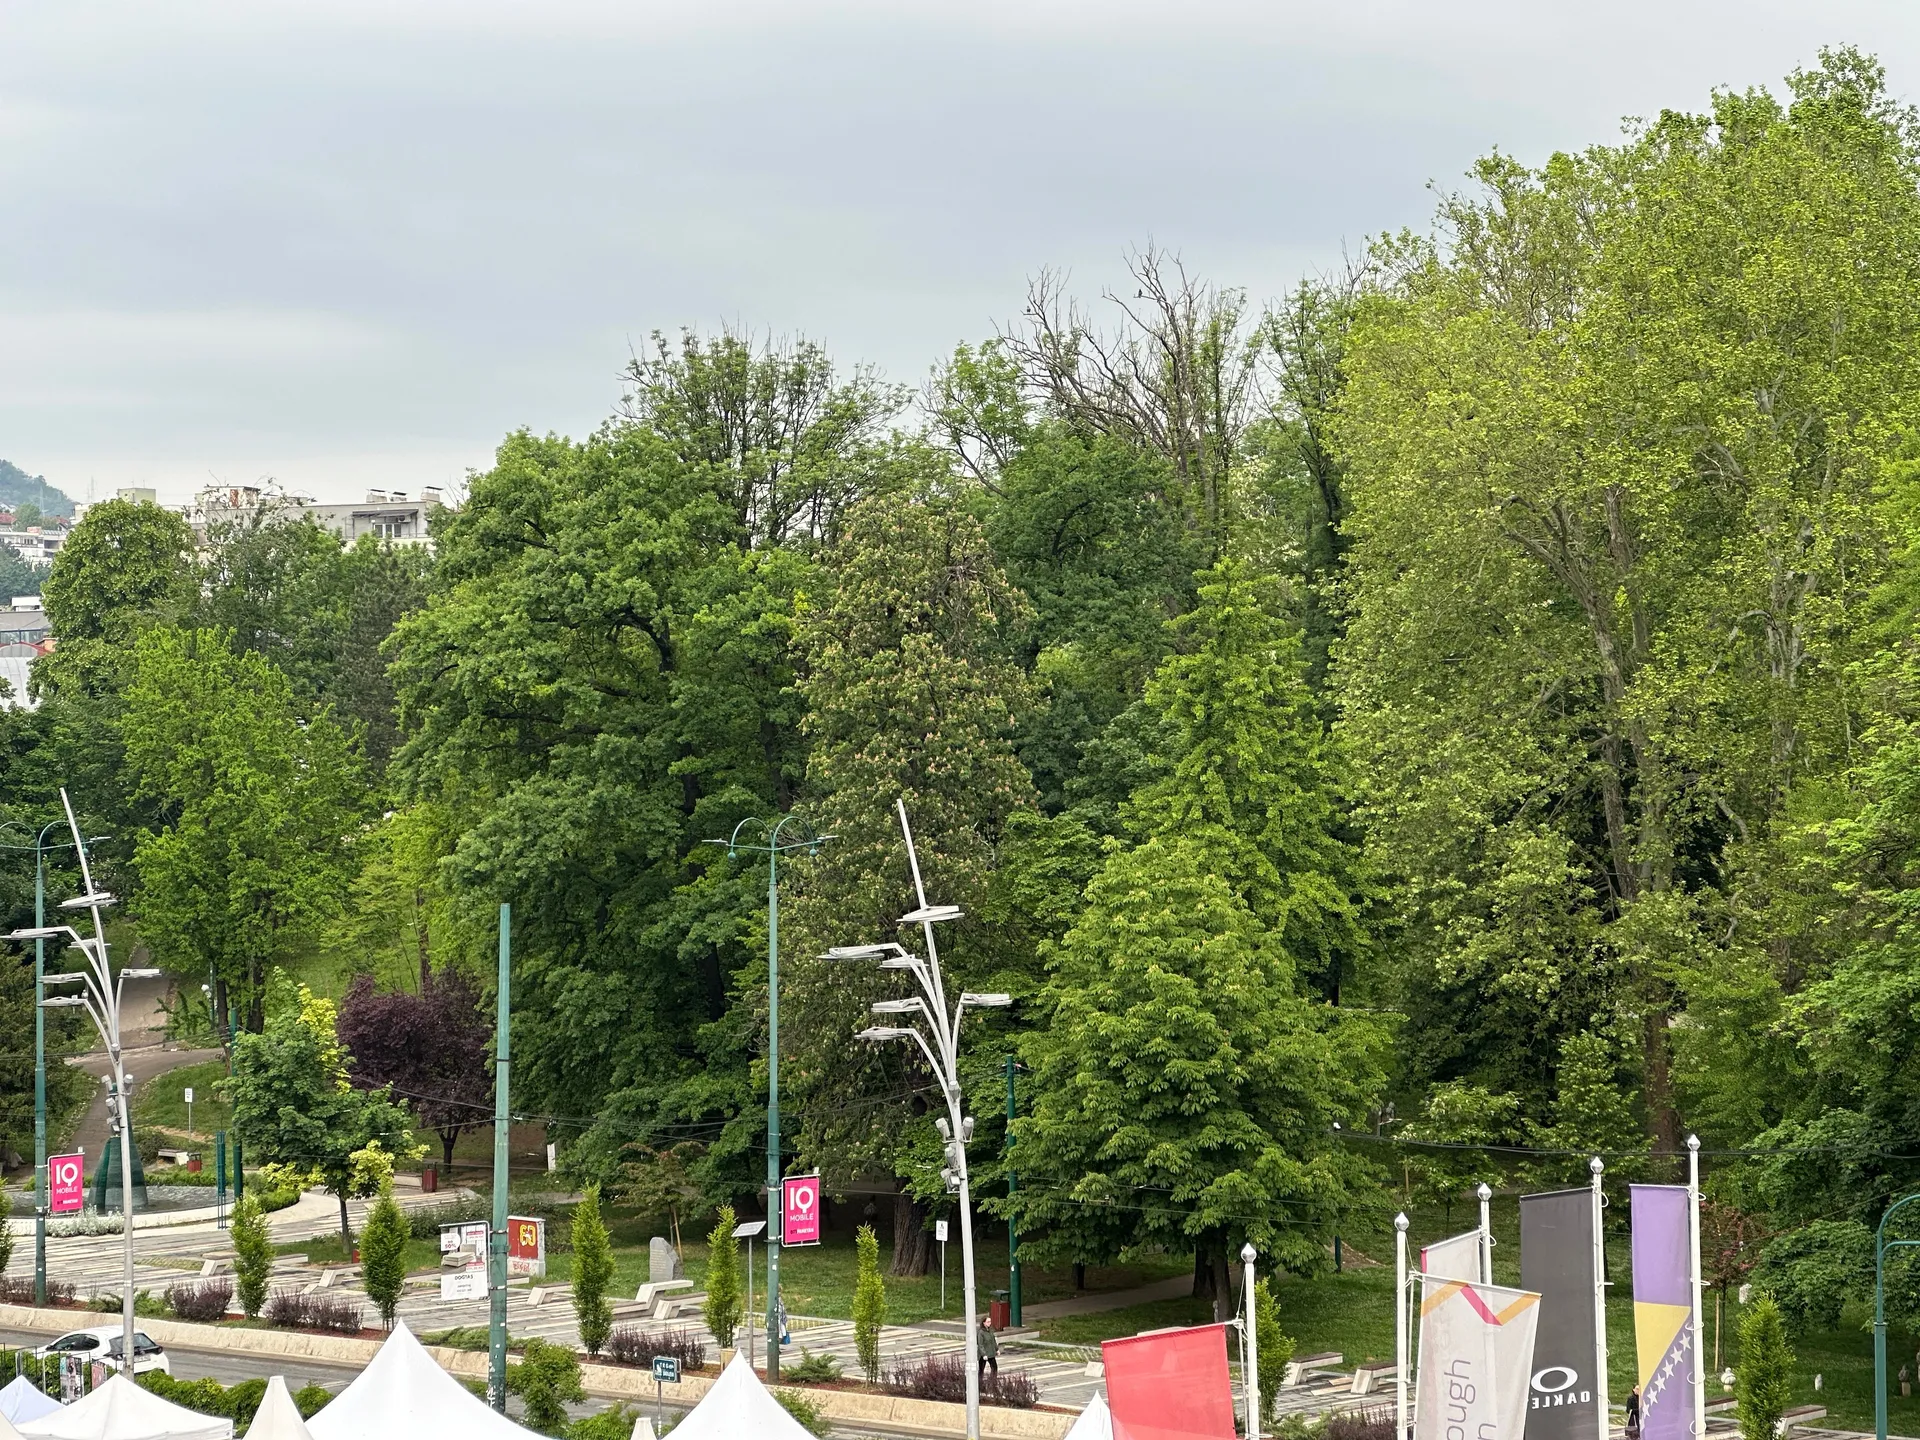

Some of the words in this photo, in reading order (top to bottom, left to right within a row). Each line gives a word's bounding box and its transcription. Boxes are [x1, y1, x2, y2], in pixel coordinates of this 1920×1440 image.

[56, 1163, 78, 1186] IQ
[56, 1186, 78, 1195] MOBILE
[790, 1186, 814, 1213] IQ
[790, 1213, 814, 1222] MOBILE
